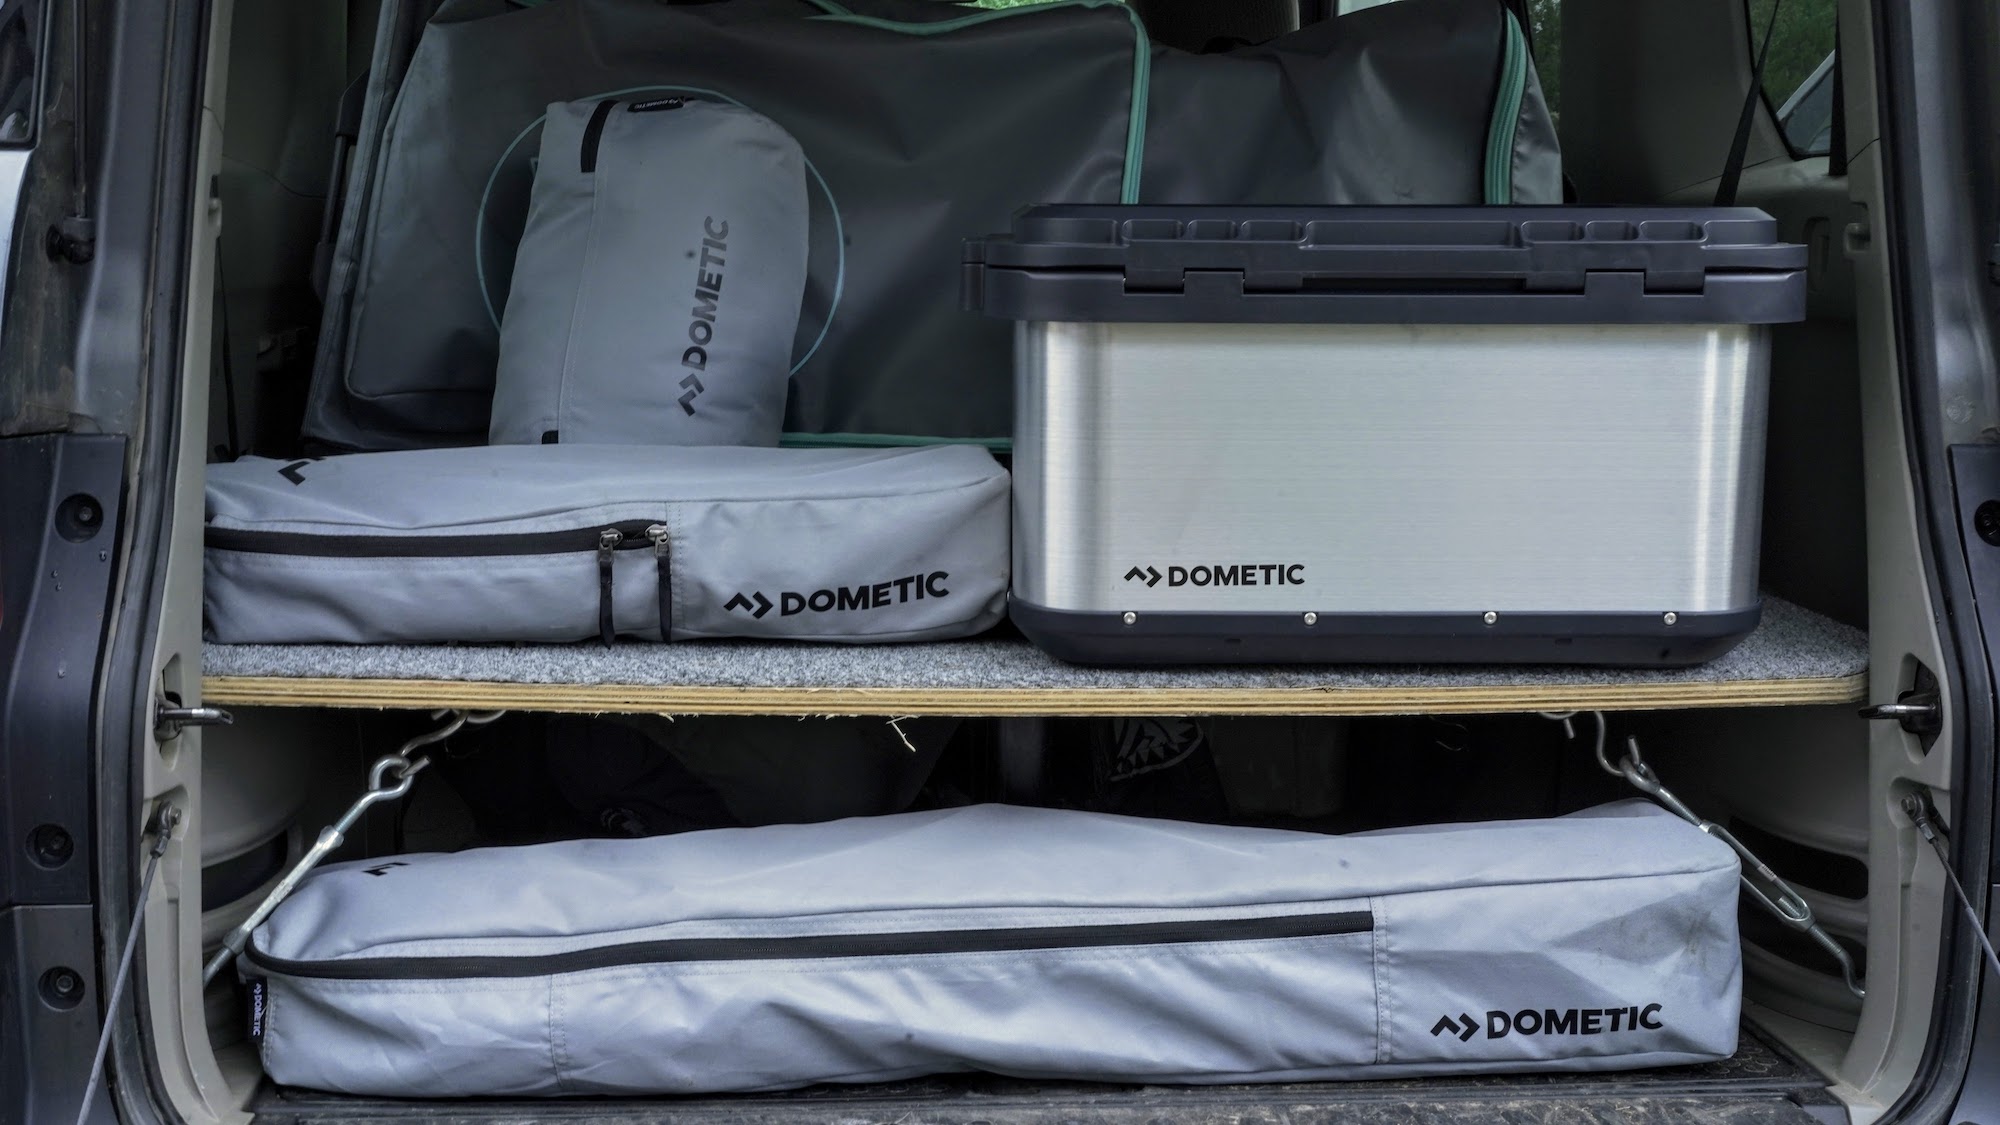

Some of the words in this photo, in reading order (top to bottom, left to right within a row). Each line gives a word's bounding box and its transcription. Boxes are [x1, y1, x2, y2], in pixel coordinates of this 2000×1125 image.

[681, 216, 729, 372] DOMETIC
[781, 571, 949, 616] DOMETIC
[1168, 564, 1305, 587] DOMETIC
[253, 994, 263, 1036] DOMETIC
[1487, 1003, 1664, 1039] DOMETIC
